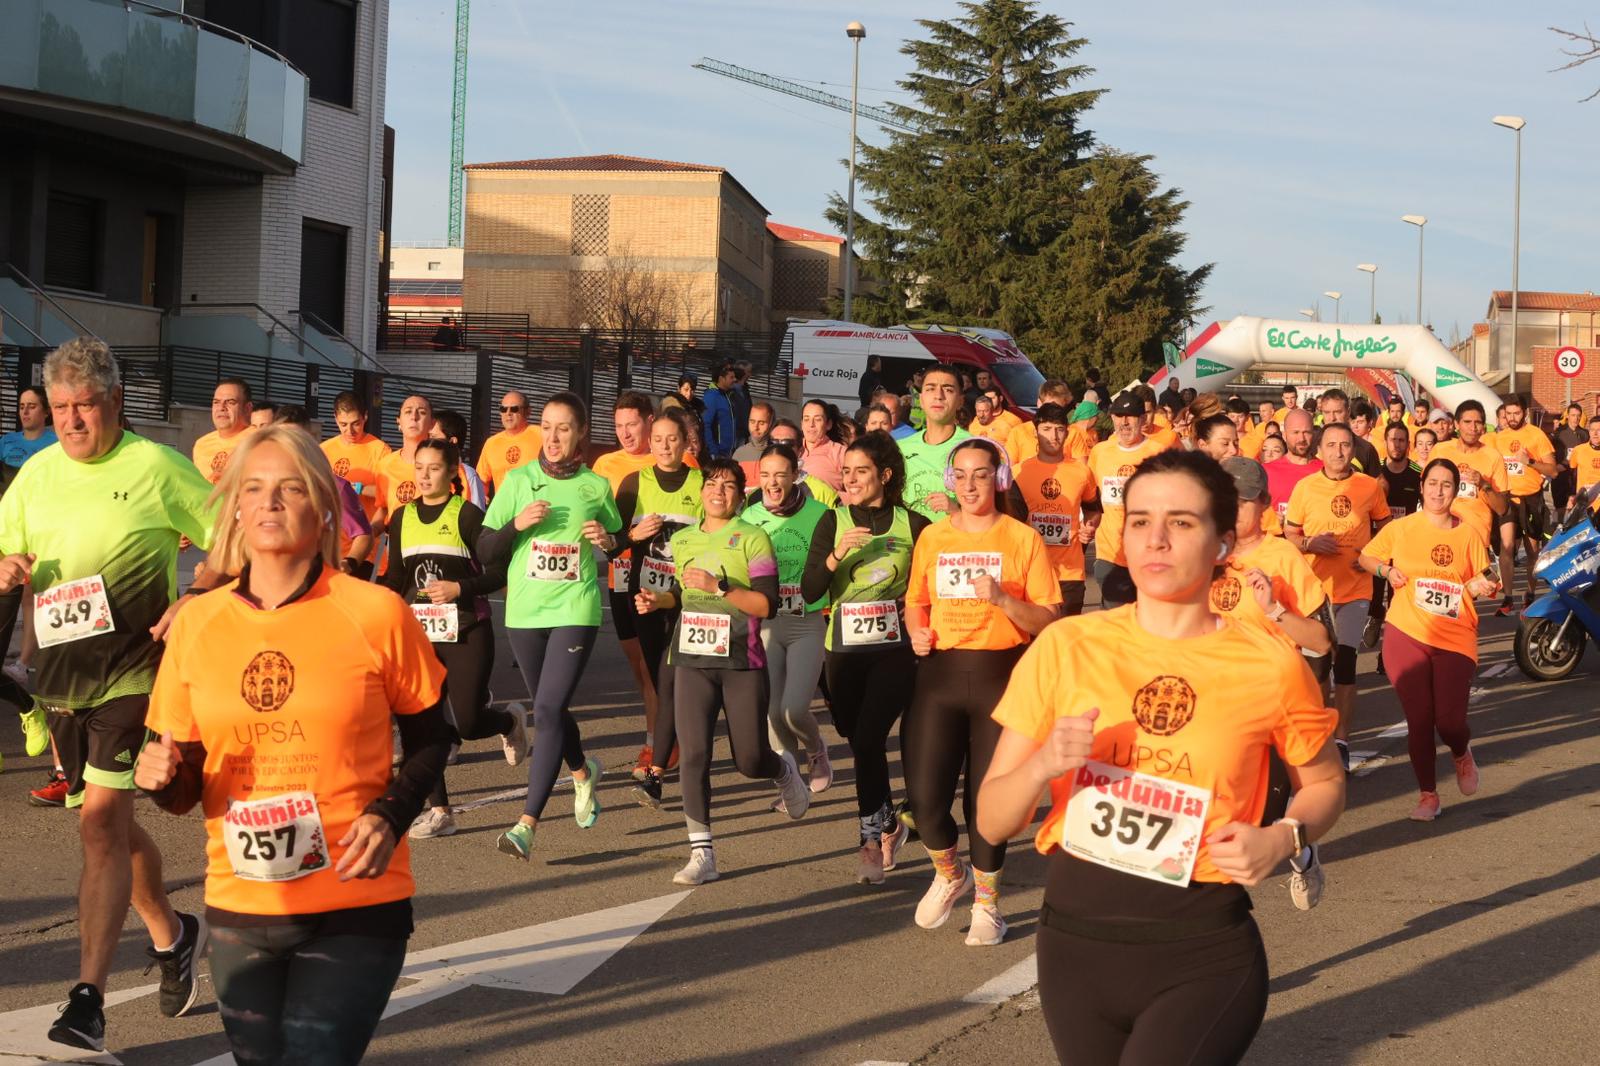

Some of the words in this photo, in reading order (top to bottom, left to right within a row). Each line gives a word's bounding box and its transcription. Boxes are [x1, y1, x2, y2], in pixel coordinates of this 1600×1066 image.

[851, 331, 909, 341] AMBULANCIA
[1267, 327, 1286, 348] El
[1287, 330, 1331, 351] Corte
[1333, 328, 1398, 359] Inglés
[1561, 356, 1578, 368] 30
[812, 367, 834, 378] Cruz
[836, 369, 858, 380] Roja
[1031, 514, 1070, 525] bedunia
[1327, 520, 1354, 530] UPSA
[1038, 524, 1064, 538] 389
[532, 541, 579, 554] bedunia
[537, 555, 569, 571] 303
[644, 558, 676, 573] bedun
[938, 555, 1000, 567] bedunia
[37, 582, 102, 609] bedunia
[1417, 580, 1461, 595] bedunia
[1425, 590, 1450, 608] 251
[48, 600, 92, 629] 349
[843, 603, 896, 616] bedunia
[683, 614, 729, 627] bedunia
[853, 616, 887, 634] 275
[688, 628, 717, 644] 230
[233, 719, 306, 745] UPSA
[1112, 742, 1193, 778] UPSA
[1076, 764, 1204, 818] bedunia
[224, 799, 315, 827] bedunia
[1090, 801, 1174, 851] 357
[238, 825, 297, 861] 257
